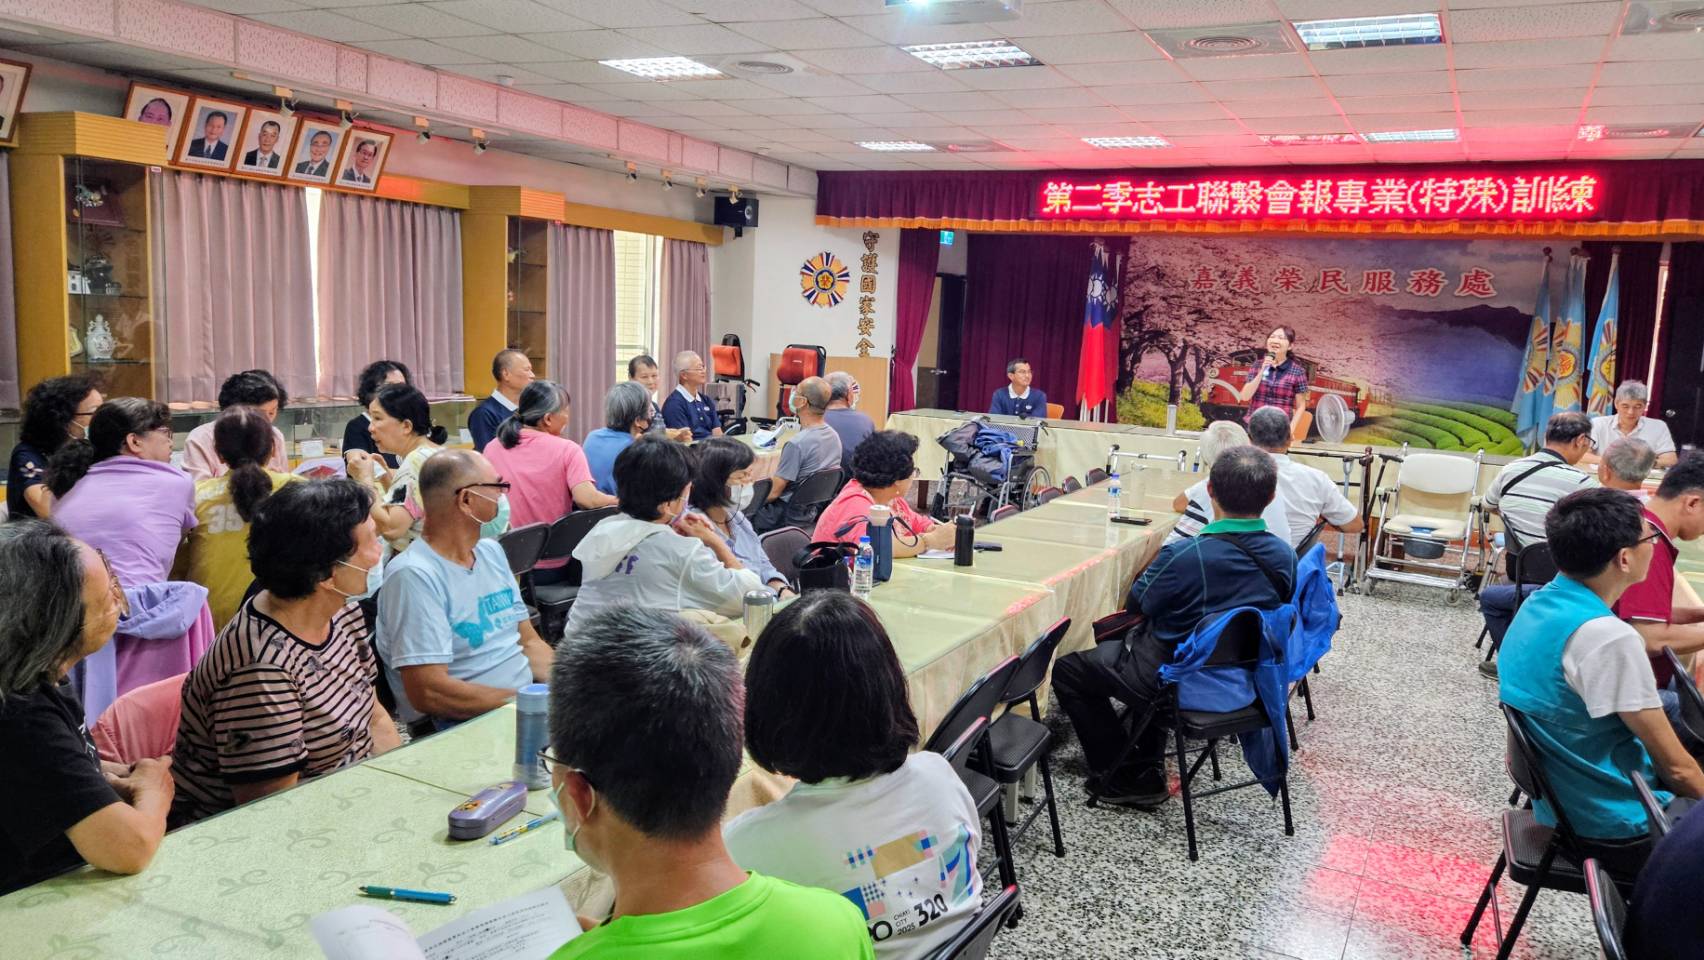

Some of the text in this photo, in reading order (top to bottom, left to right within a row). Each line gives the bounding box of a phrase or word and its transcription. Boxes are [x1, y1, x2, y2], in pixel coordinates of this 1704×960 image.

[1043, 176, 1597, 214] 第二季志工聯繫會報專業(特殊)訓練
[856, 230, 880, 358] 守護國家安全
[1191, 266, 1496, 297] 嘉義榮民服務處
[914, 893, 948, 926] 320
[897, 922, 916, 936] 2025
